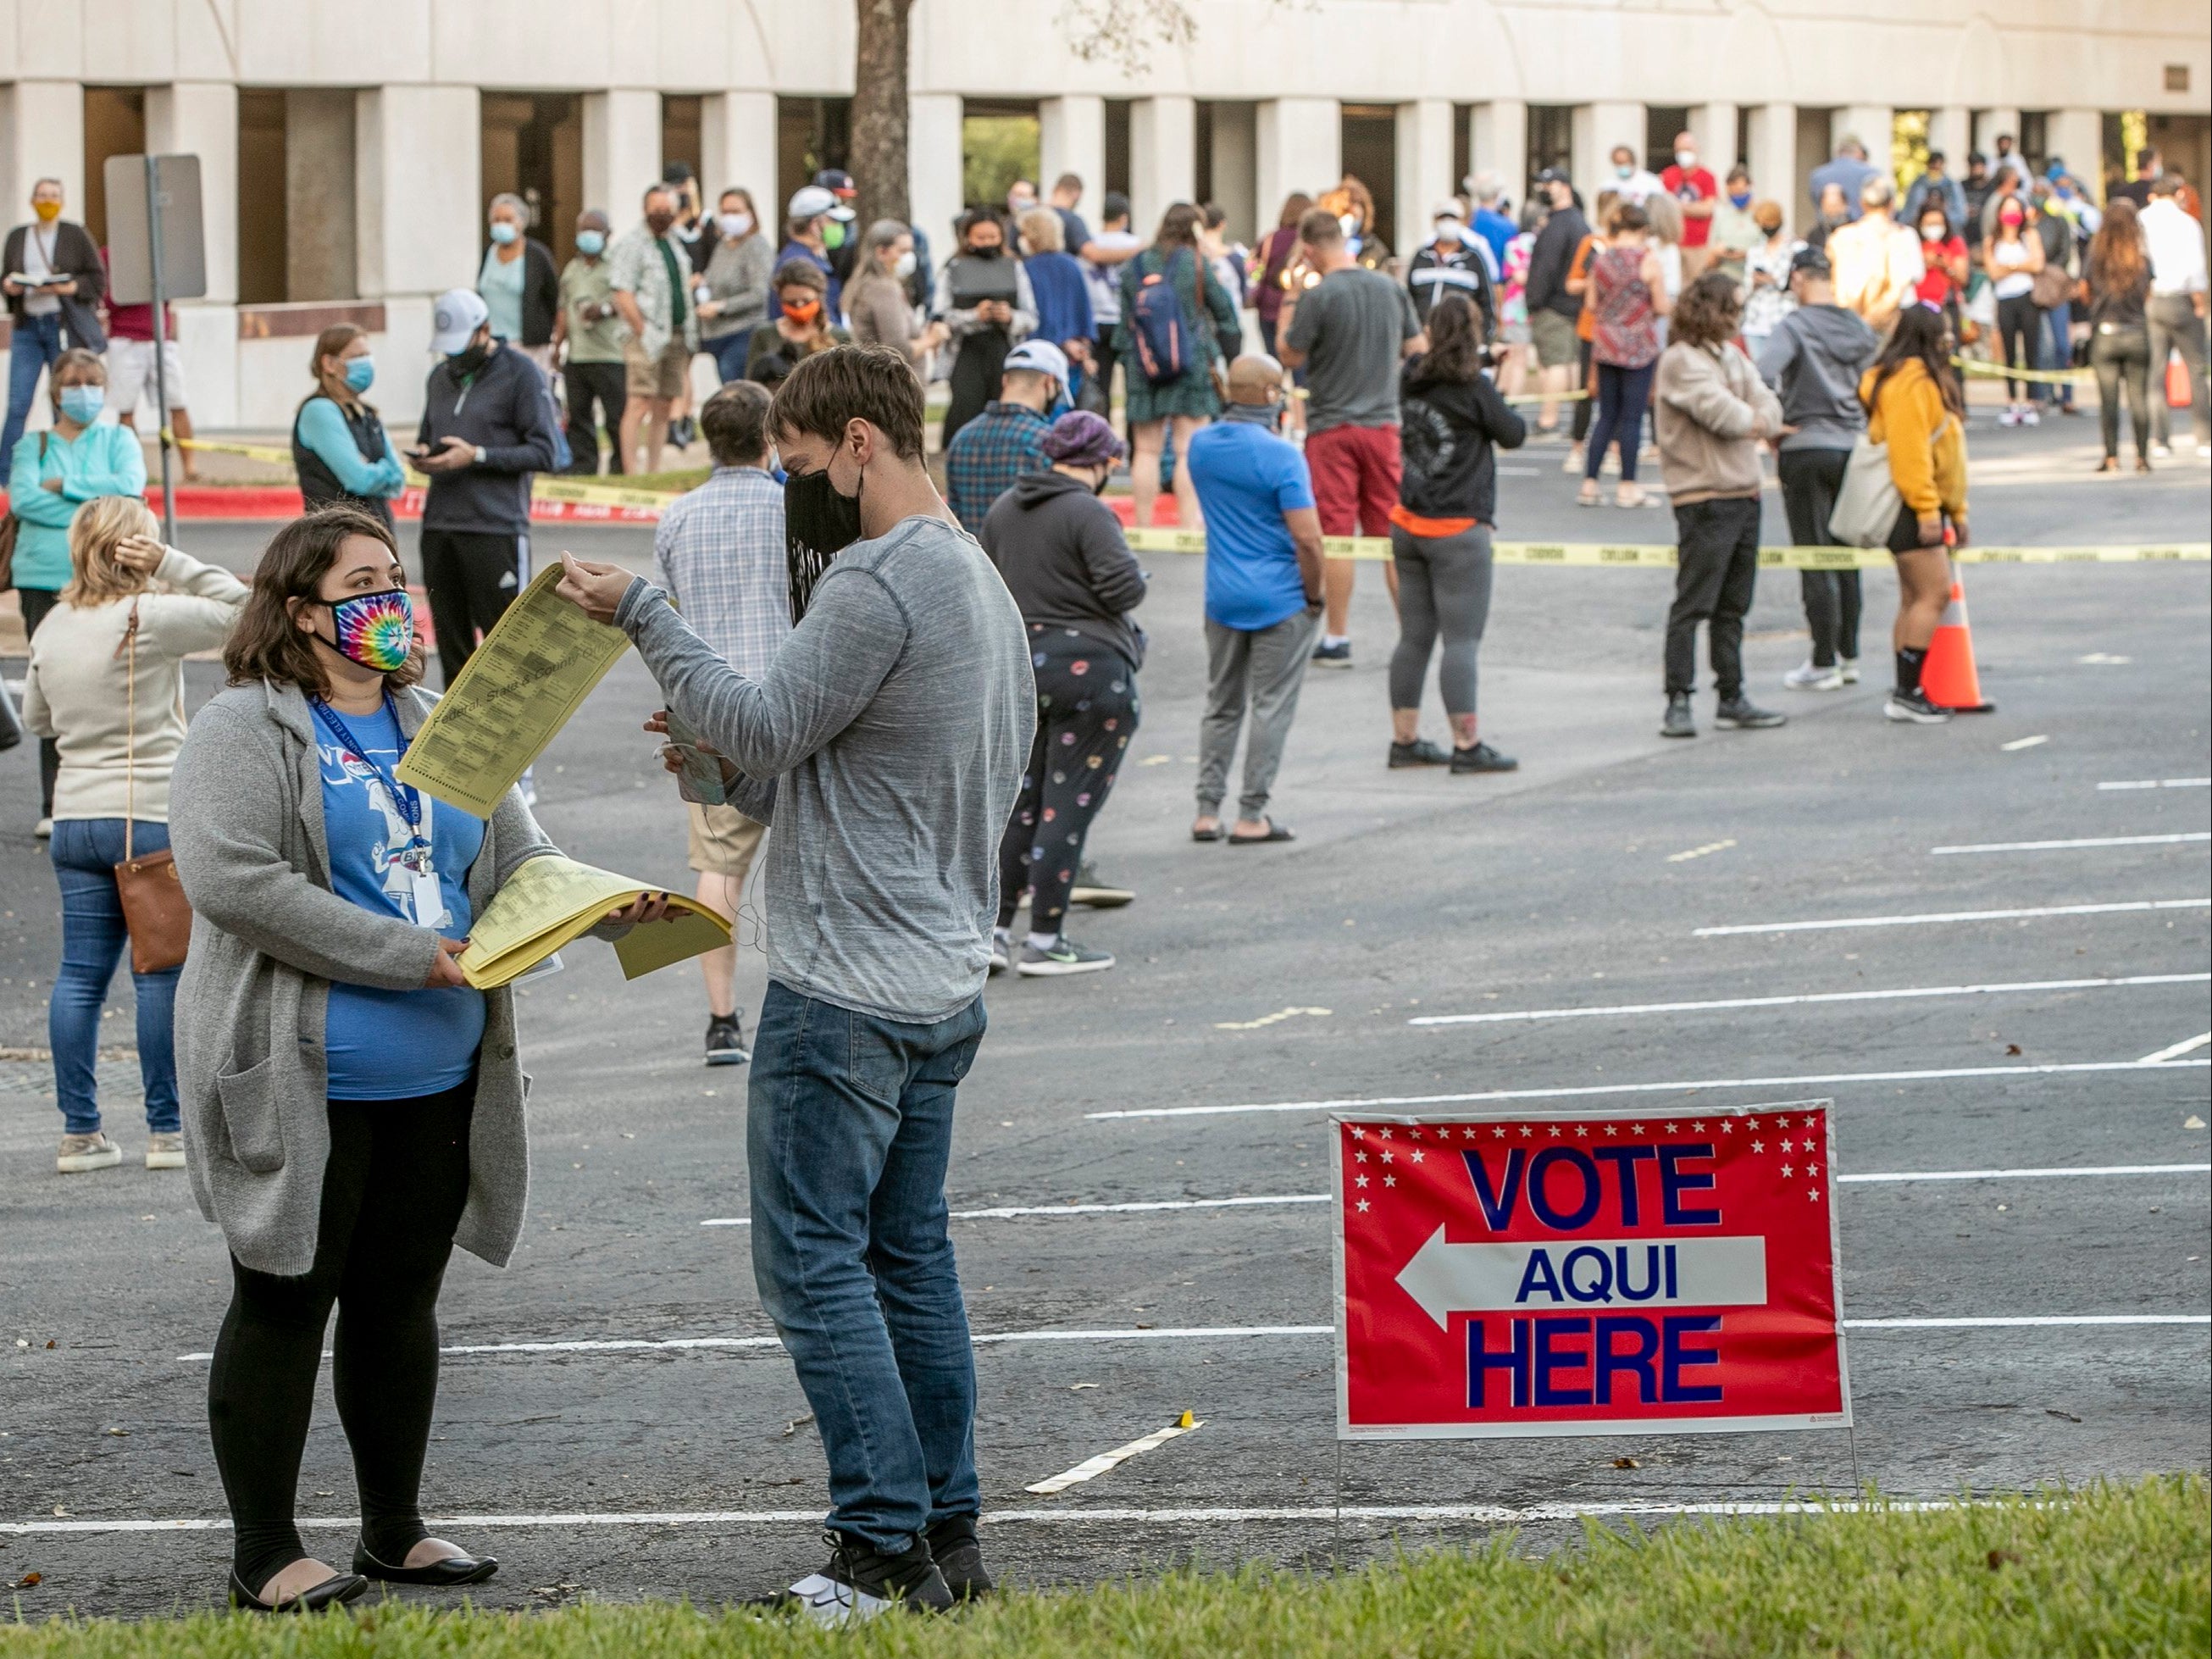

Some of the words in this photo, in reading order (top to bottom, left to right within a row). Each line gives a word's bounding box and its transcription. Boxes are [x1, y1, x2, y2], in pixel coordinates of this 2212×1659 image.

[486, 680, 518, 702] State
[534, 653, 579, 680] County
[1461, 1144, 1723, 1231] VOTE
[1515, 1245, 1678, 1304] AQUI
[1466, 1315, 1724, 1409] HERE
